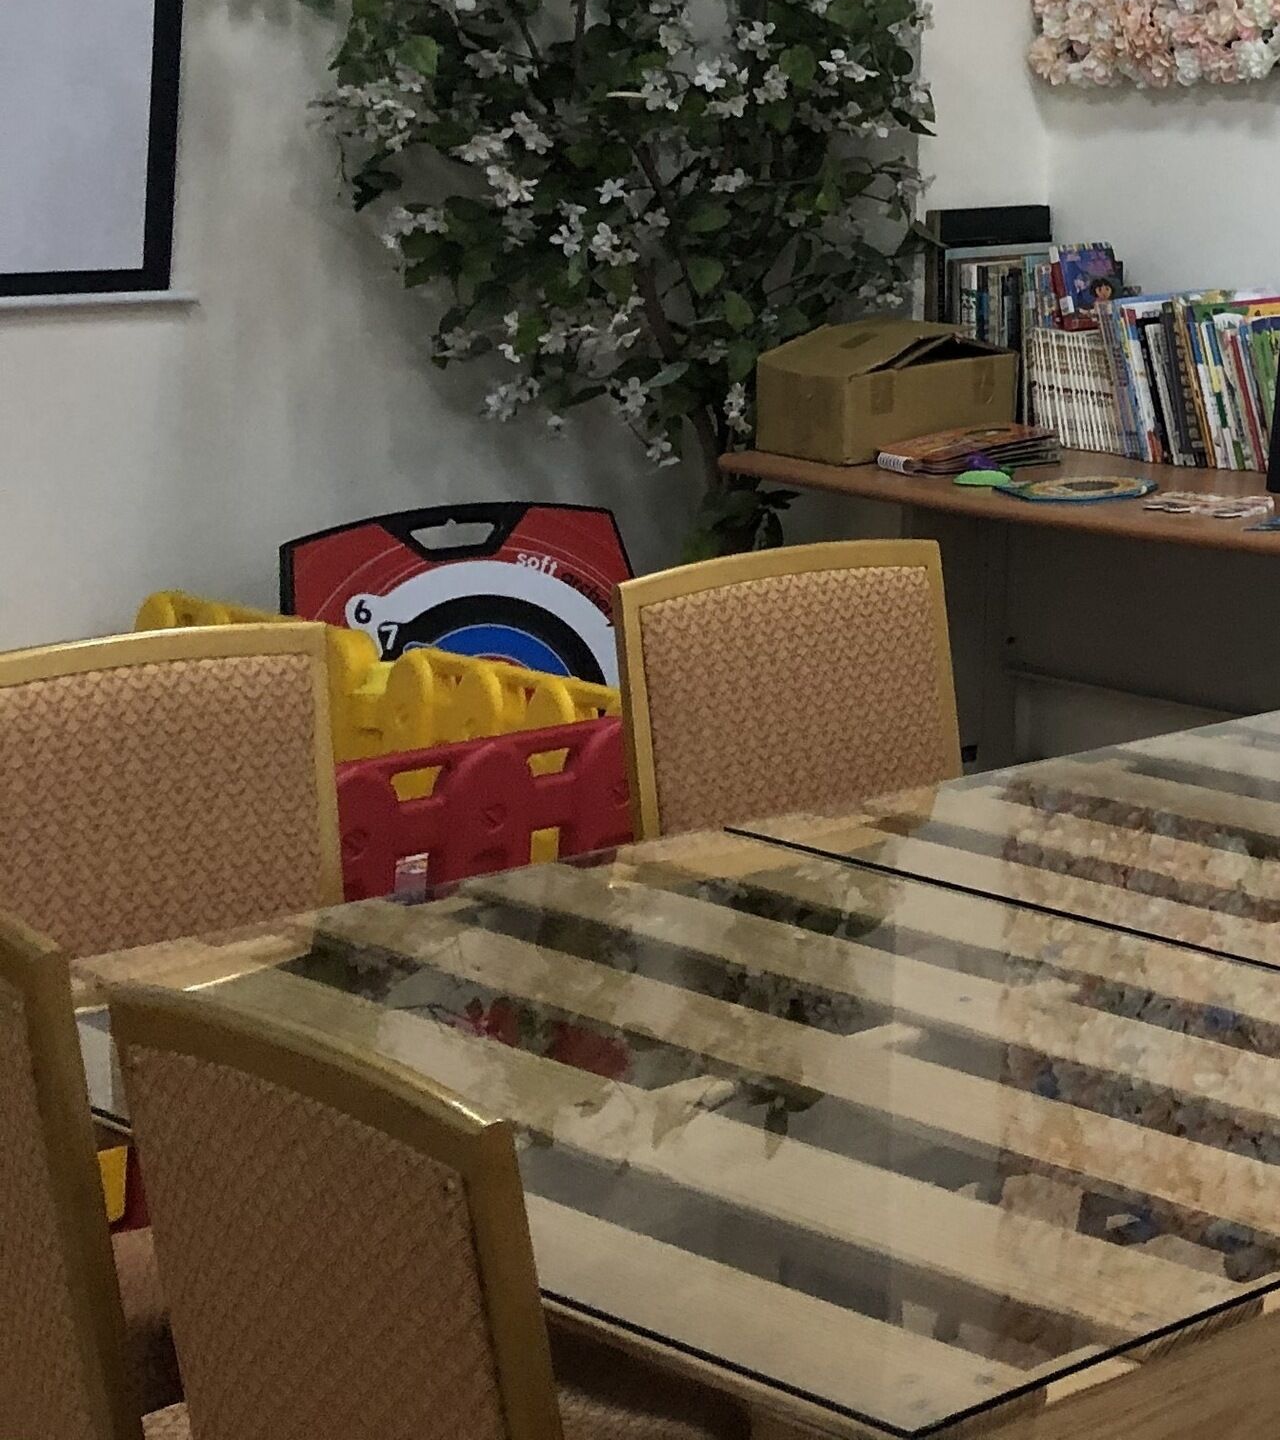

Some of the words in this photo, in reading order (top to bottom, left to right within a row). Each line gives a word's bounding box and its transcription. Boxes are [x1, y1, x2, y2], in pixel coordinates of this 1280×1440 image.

[516, 553, 558, 577] soft
[354, 598, 372, 625] 6
[380, 624, 398, 650] 7
